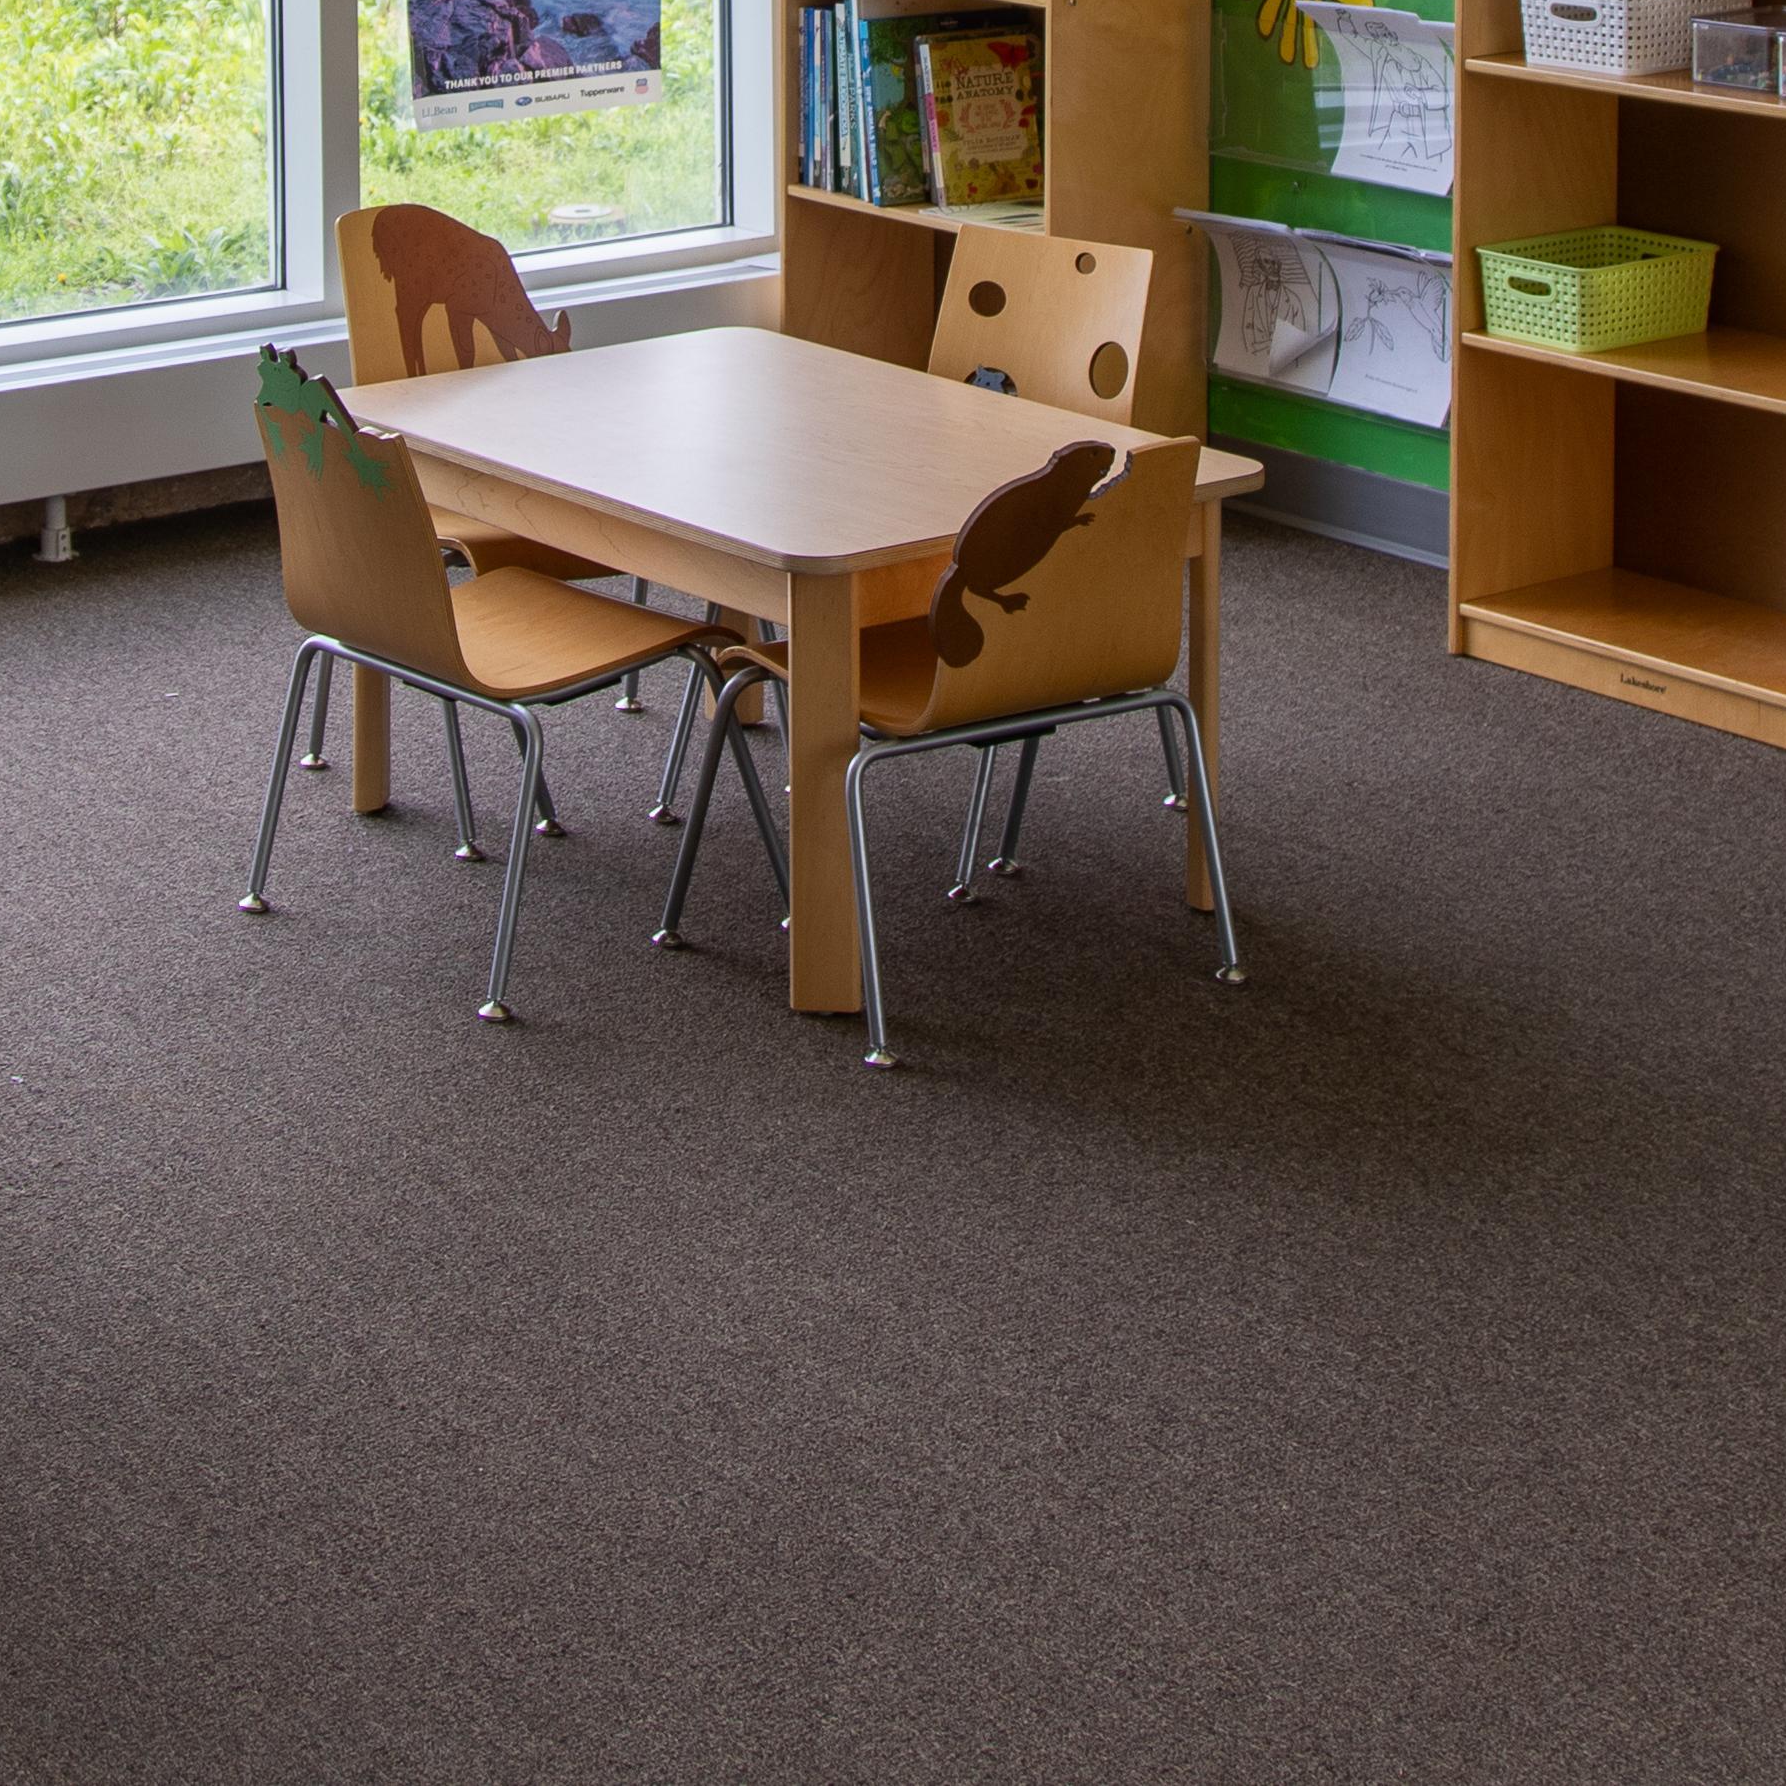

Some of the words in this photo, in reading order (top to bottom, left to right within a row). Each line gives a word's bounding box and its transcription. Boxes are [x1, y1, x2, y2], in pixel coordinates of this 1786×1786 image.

[445, 78, 478, 90] THANK
[479, 76, 499, 85] YOU
[501, 74, 512, 83] TO
[514, 72, 533, 82] OUR
[535, 67, 574, 80] PREMIER
[575, 61, 622, 74] PARTNERS
[955, 72, 1014, 90] NATURE
[580, 85, 625, 98] Tupperware
[956, 86, 1014, 101] ANATOMY
